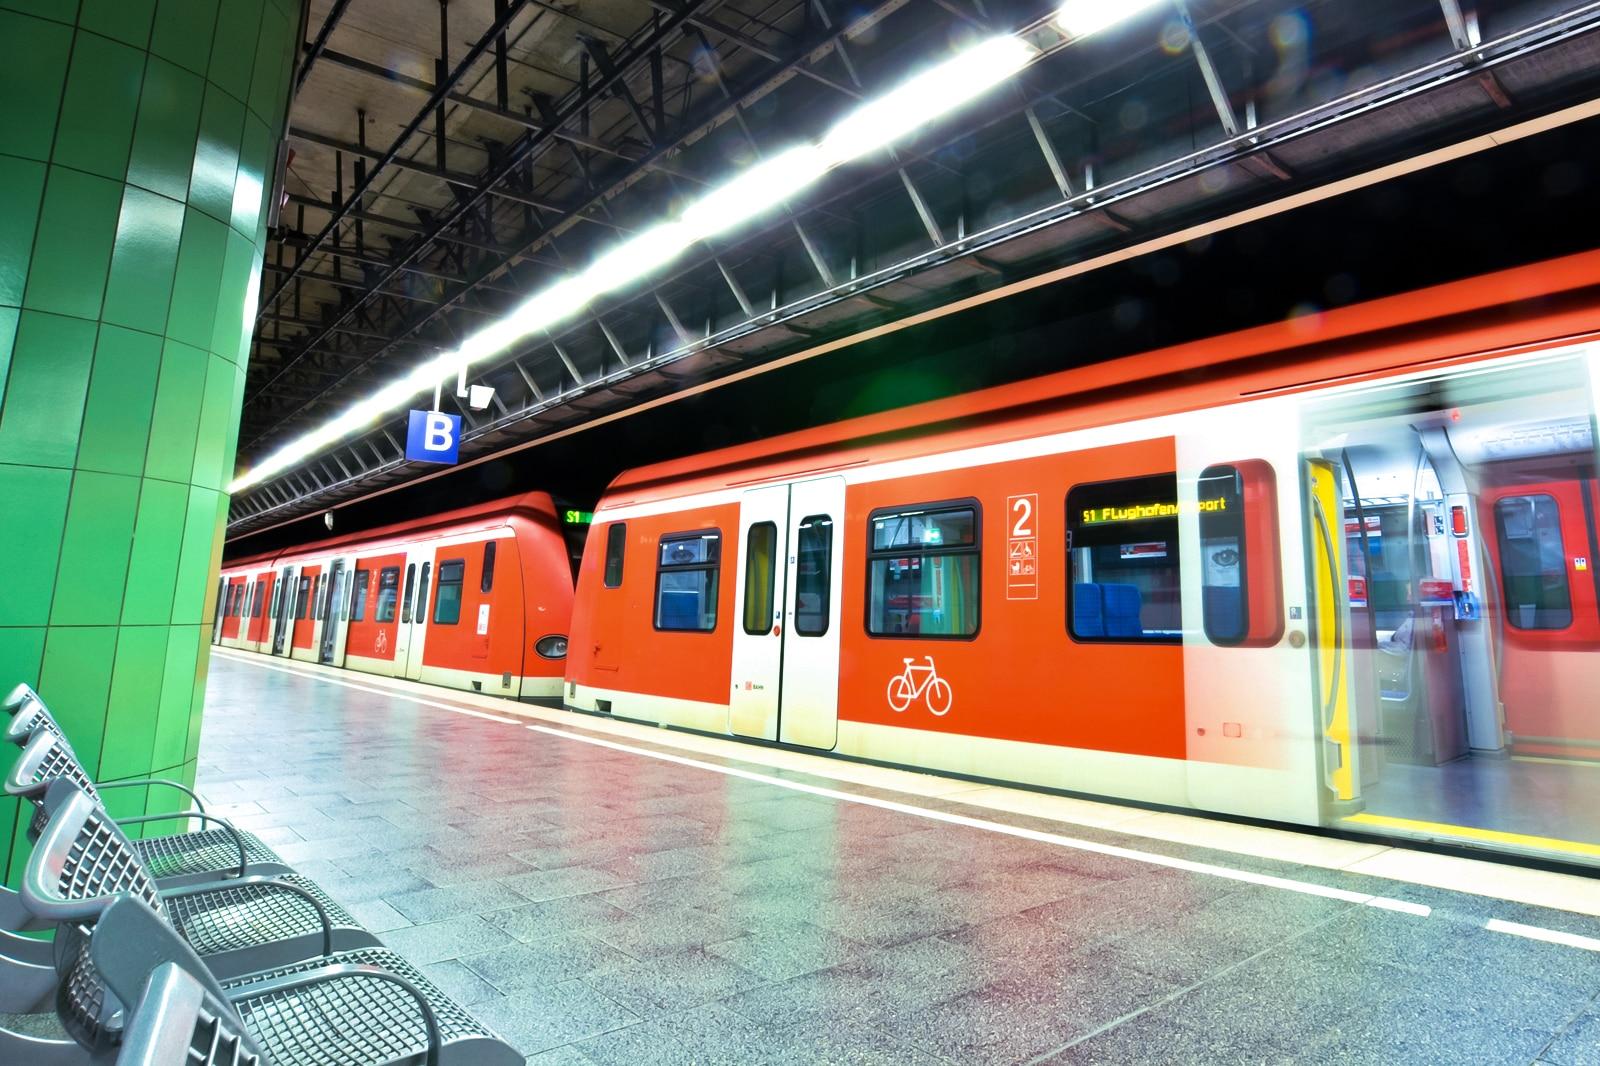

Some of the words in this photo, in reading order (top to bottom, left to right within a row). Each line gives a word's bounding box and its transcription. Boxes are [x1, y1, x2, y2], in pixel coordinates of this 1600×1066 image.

[425, 413, 453, 451] B
[566, 510, 580, 523] S1
[1012, 498, 1031, 536] 2
[1083, 509, 1096, 522] S1
